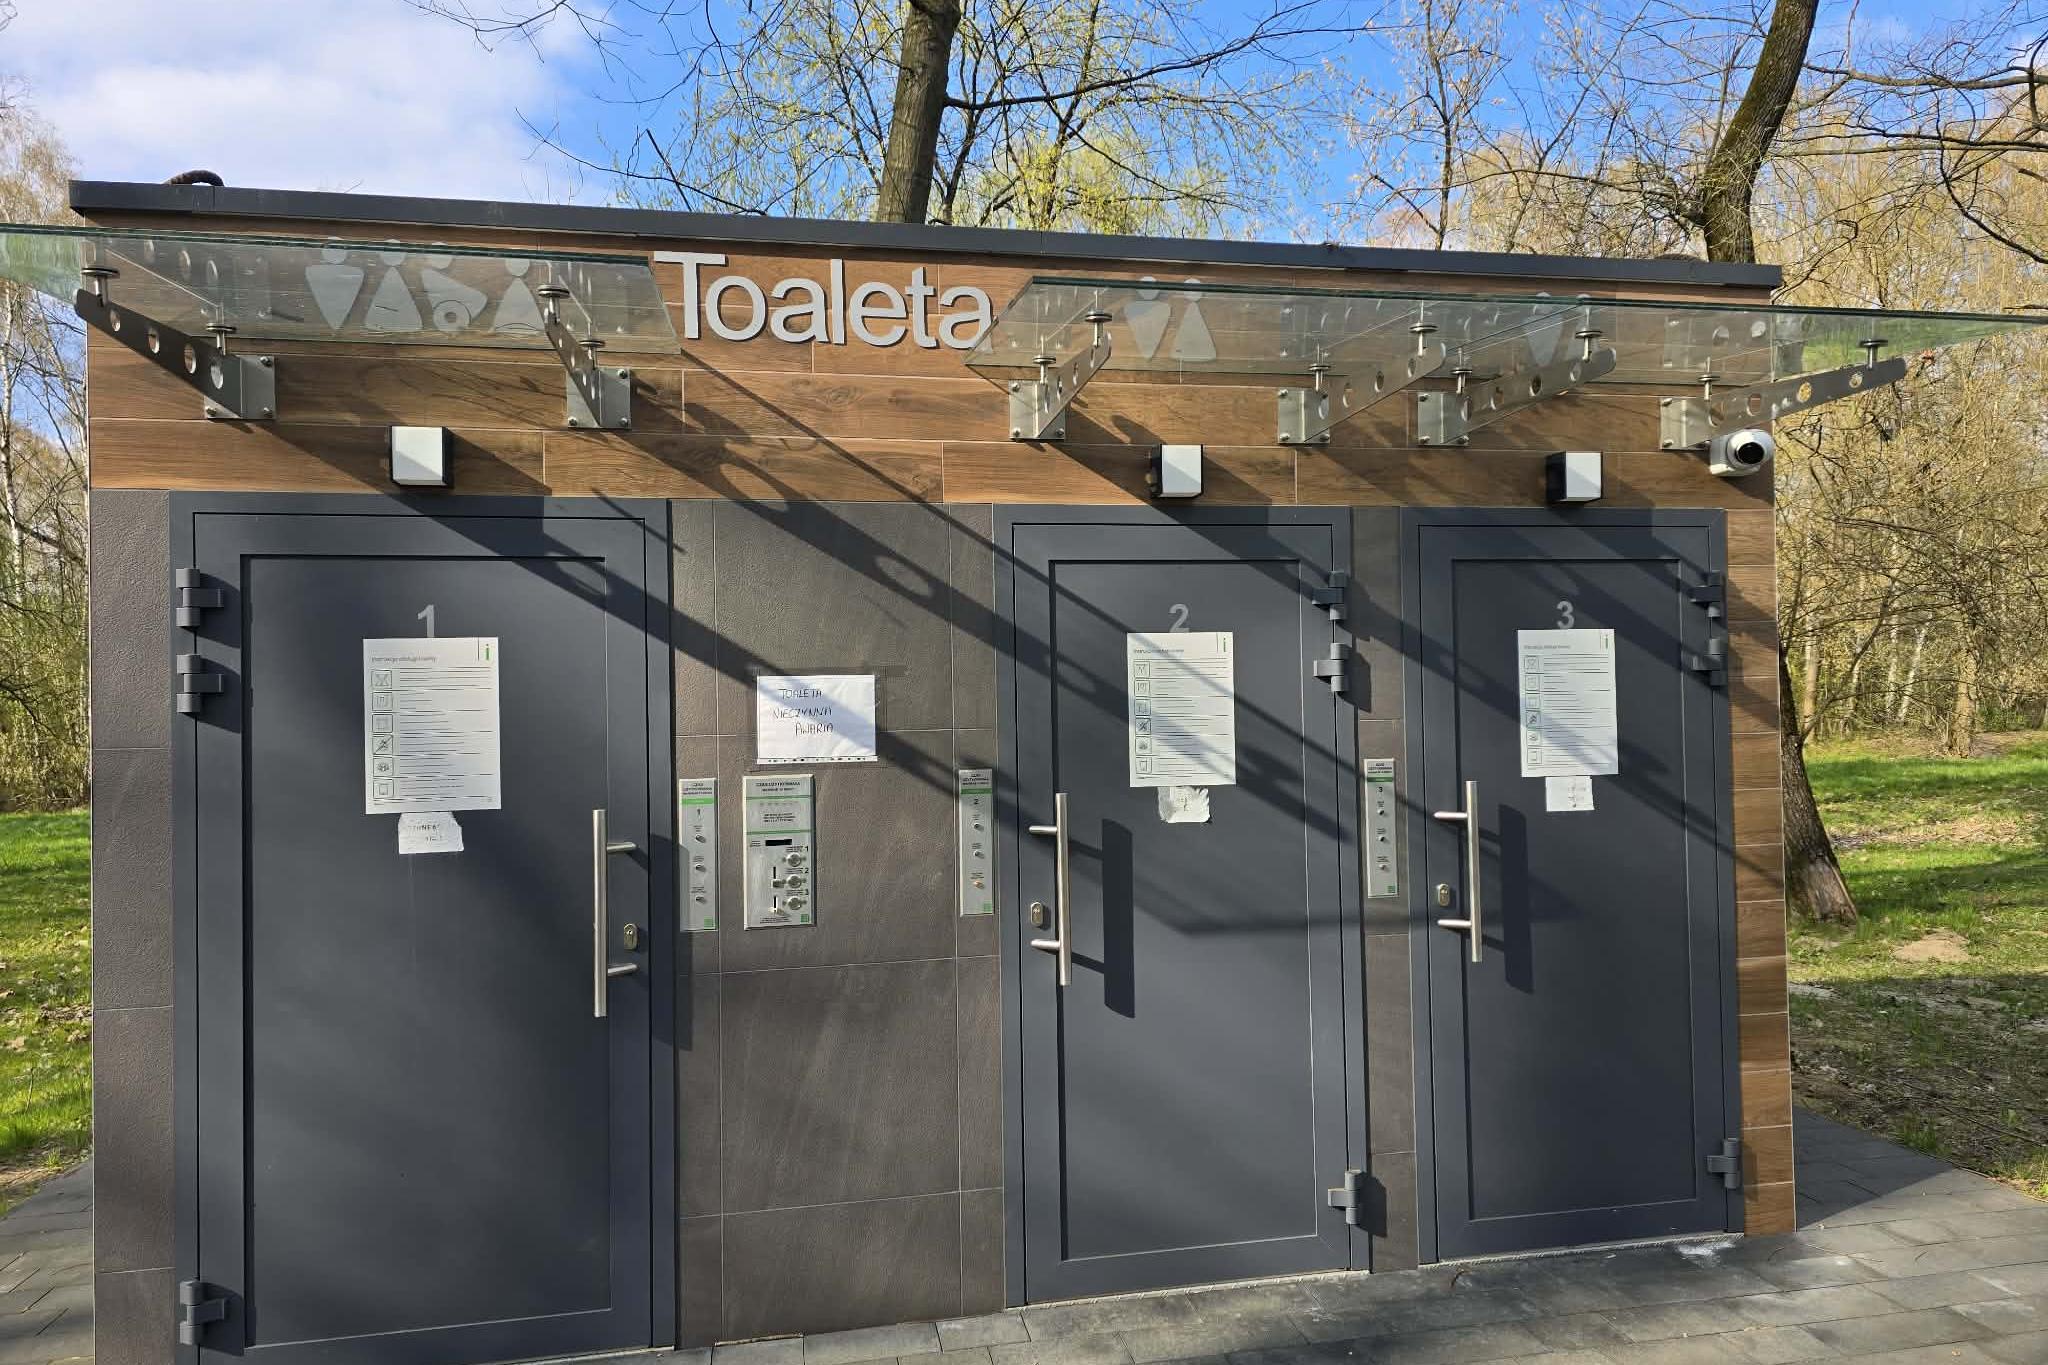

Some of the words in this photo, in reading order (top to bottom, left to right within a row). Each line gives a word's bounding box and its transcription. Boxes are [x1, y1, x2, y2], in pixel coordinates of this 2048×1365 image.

[653, 250, 994, 352] Toaleta
[417, 604, 435, 637] 1
[1168, 603, 1190, 633] 2
[1556, 601, 1575, 629] 3
[778, 688, 822, 700] TOALETA
[795, 722, 834, 737] AWARIA
